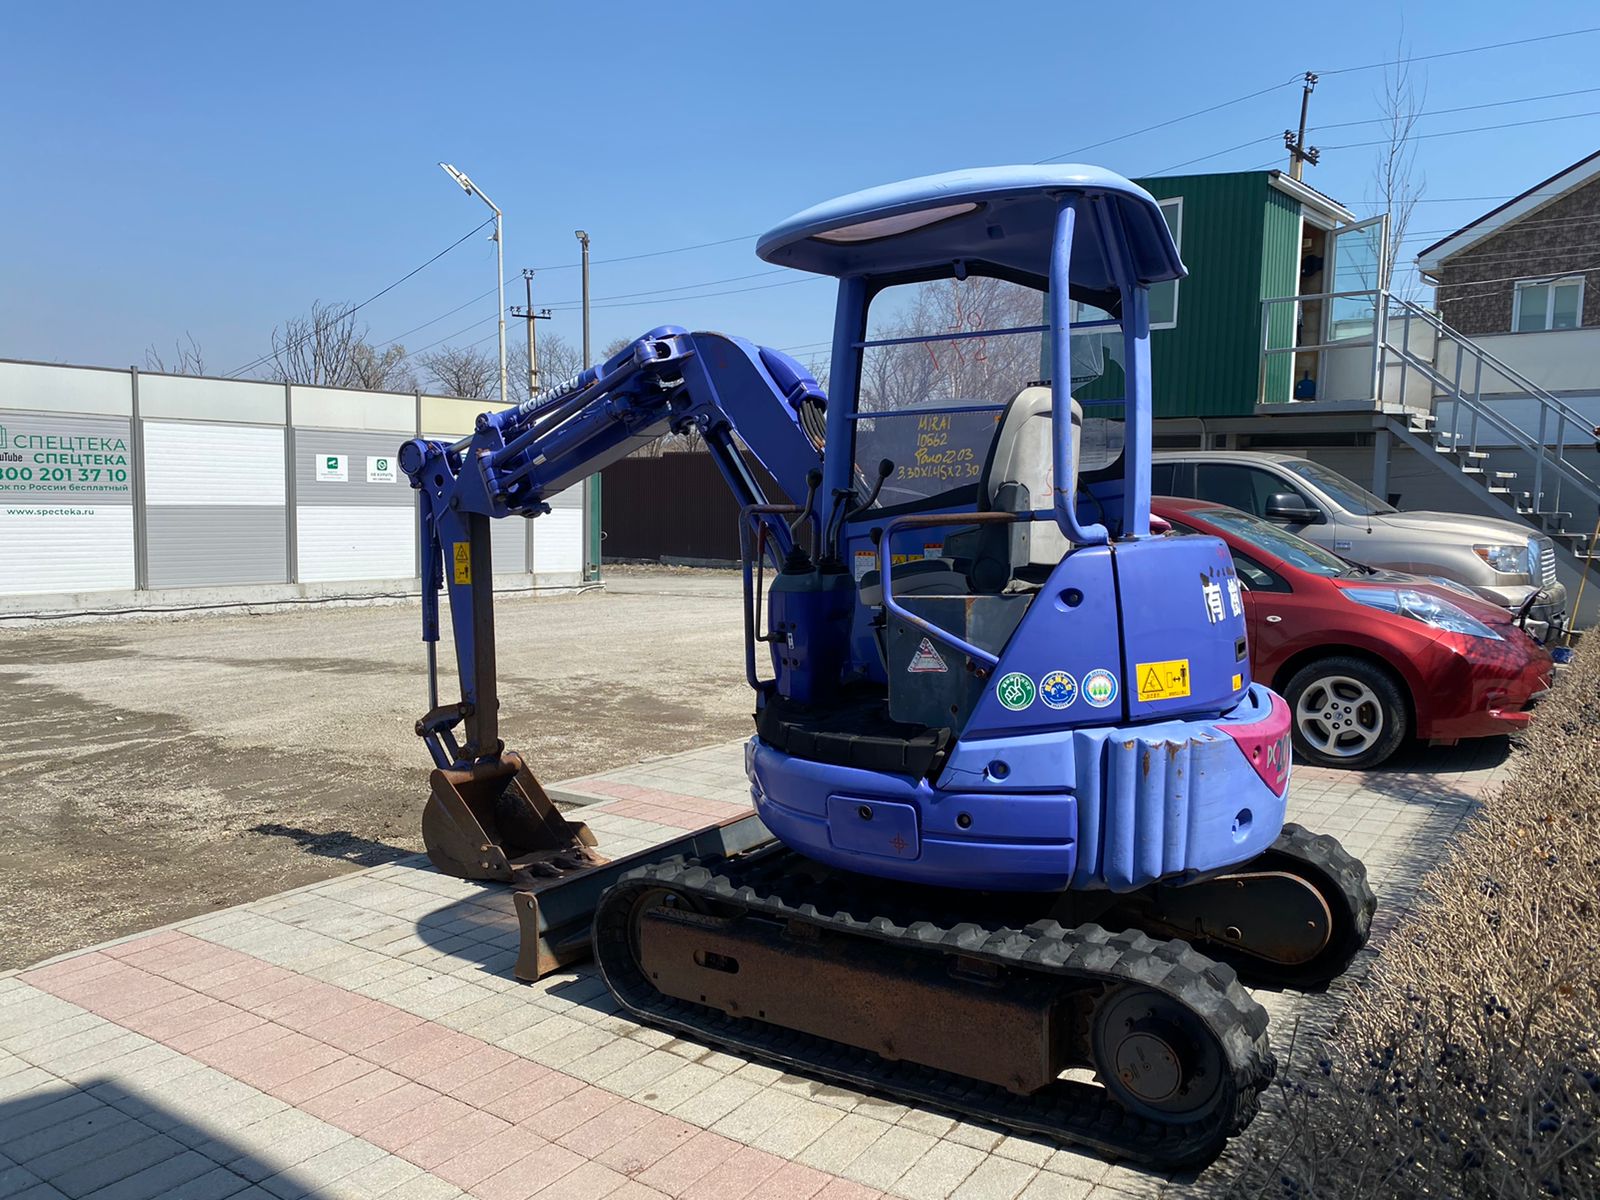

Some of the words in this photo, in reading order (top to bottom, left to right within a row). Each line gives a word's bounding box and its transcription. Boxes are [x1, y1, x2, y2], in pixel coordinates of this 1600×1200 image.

[519, 375, 579, 415] KOMATSU
[13, 435, 127, 452] СПЕЦТЕКА
[33, 453, 127, 467] СПЕЦТЕКА
[39, 467, 72, 481] 201
[79, 468, 101, 482] 37
[107, 469, 127, 482] 10
[29, 483, 66, 491] России
[69, 483, 128, 491] бесплатный
[7, 508, 94, 516] www.specteka.ru
